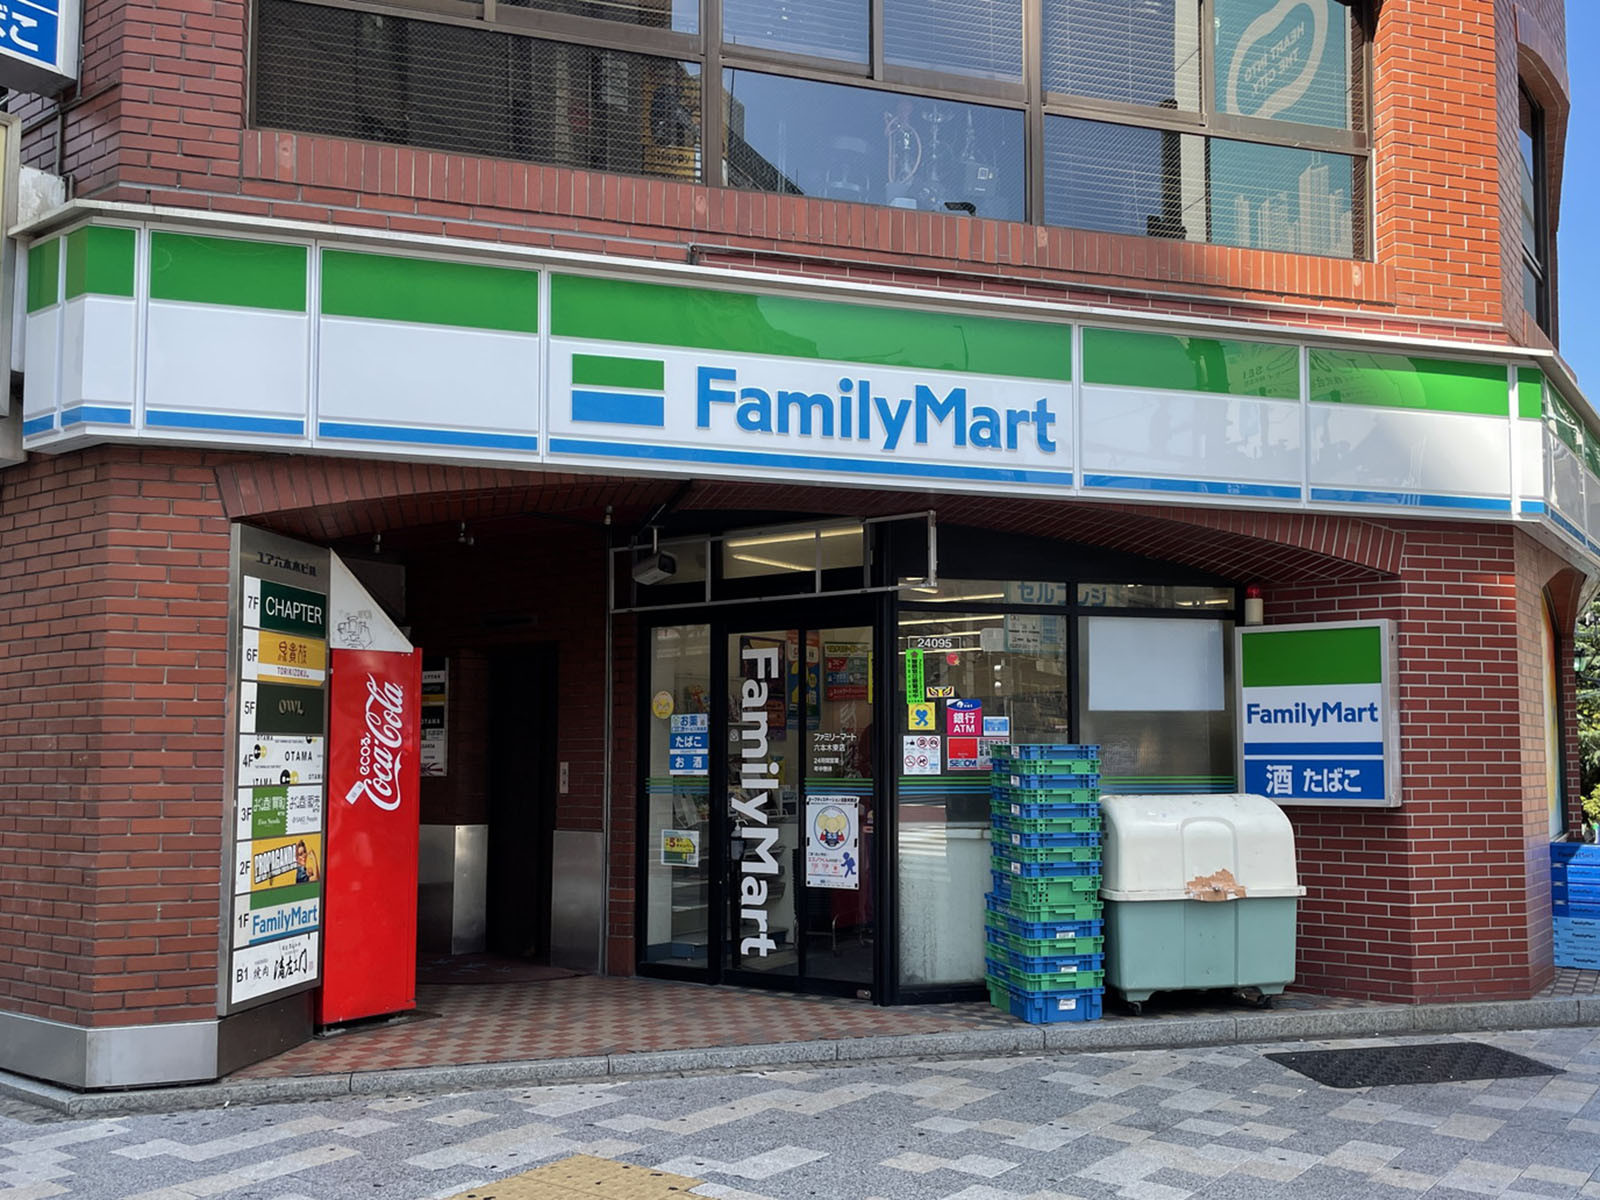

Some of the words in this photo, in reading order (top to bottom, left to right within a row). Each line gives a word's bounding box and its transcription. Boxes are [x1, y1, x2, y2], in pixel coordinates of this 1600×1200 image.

[0, 4, 39, 52] こ
[696, 366, 1057, 454] FamilyMart
[247, 595, 259, 610] 7F
[265, 596, 322, 625] CHAPTER
[917, 638, 953, 649] 24095
[246, 648, 258, 662] 6F
[244, 701, 255, 715] 5F
[278, 699, 304, 715] OWL
[1246, 701, 1379, 727] FamilyMart
[953, 712, 976, 724] 銀行
[953, 724, 976, 733] ATM
[363, 672, 404, 811] Coca-Cola
[675, 735, 703, 748] たばこ
[813, 732, 857, 742] ファミリーマート
[242, 754, 253, 768] 4F
[284, 751, 313, 761] OTAMA
[949, 759, 977, 767] SECOM
[1265, 764, 1293, 795] 酒
[1303, 767, 1362, 793] たばこ
[730, 646, 779, 958] FamilyMart
[241, 807, 252, 822] 3F
[239, 861, 251, 875] 2F
[238, 913, 250, 928] 1F
[252, 904, 318, 936] FamilyMart
[236, 967, 248, 983] B1
